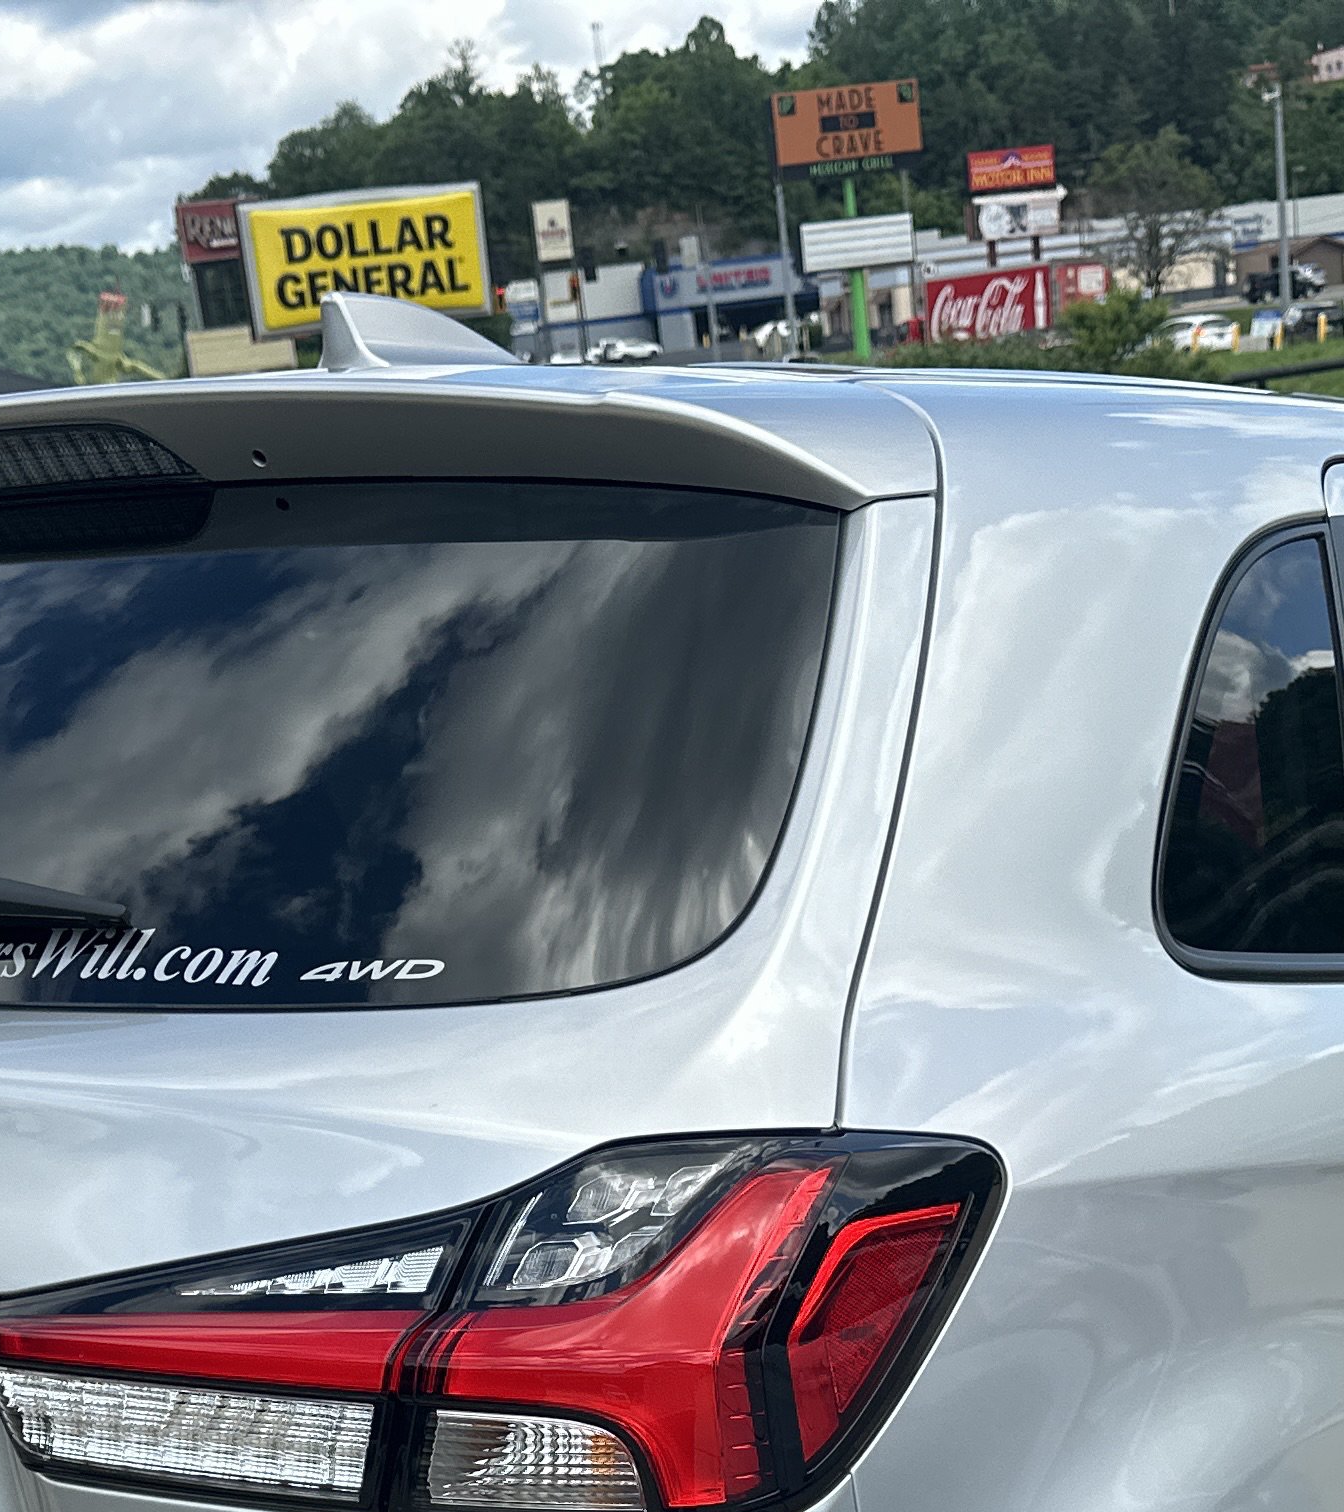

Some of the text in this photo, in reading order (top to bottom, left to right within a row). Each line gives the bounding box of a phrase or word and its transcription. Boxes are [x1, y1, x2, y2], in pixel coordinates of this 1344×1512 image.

[816, 87, 875, 113] MADE
[816, 130, 885, 158] CRAVE
[280, 214, 454, 265] DOLLAR
[275, 257, 470, 310] GENERAL
[298, 959, 446, 983] 4WD
